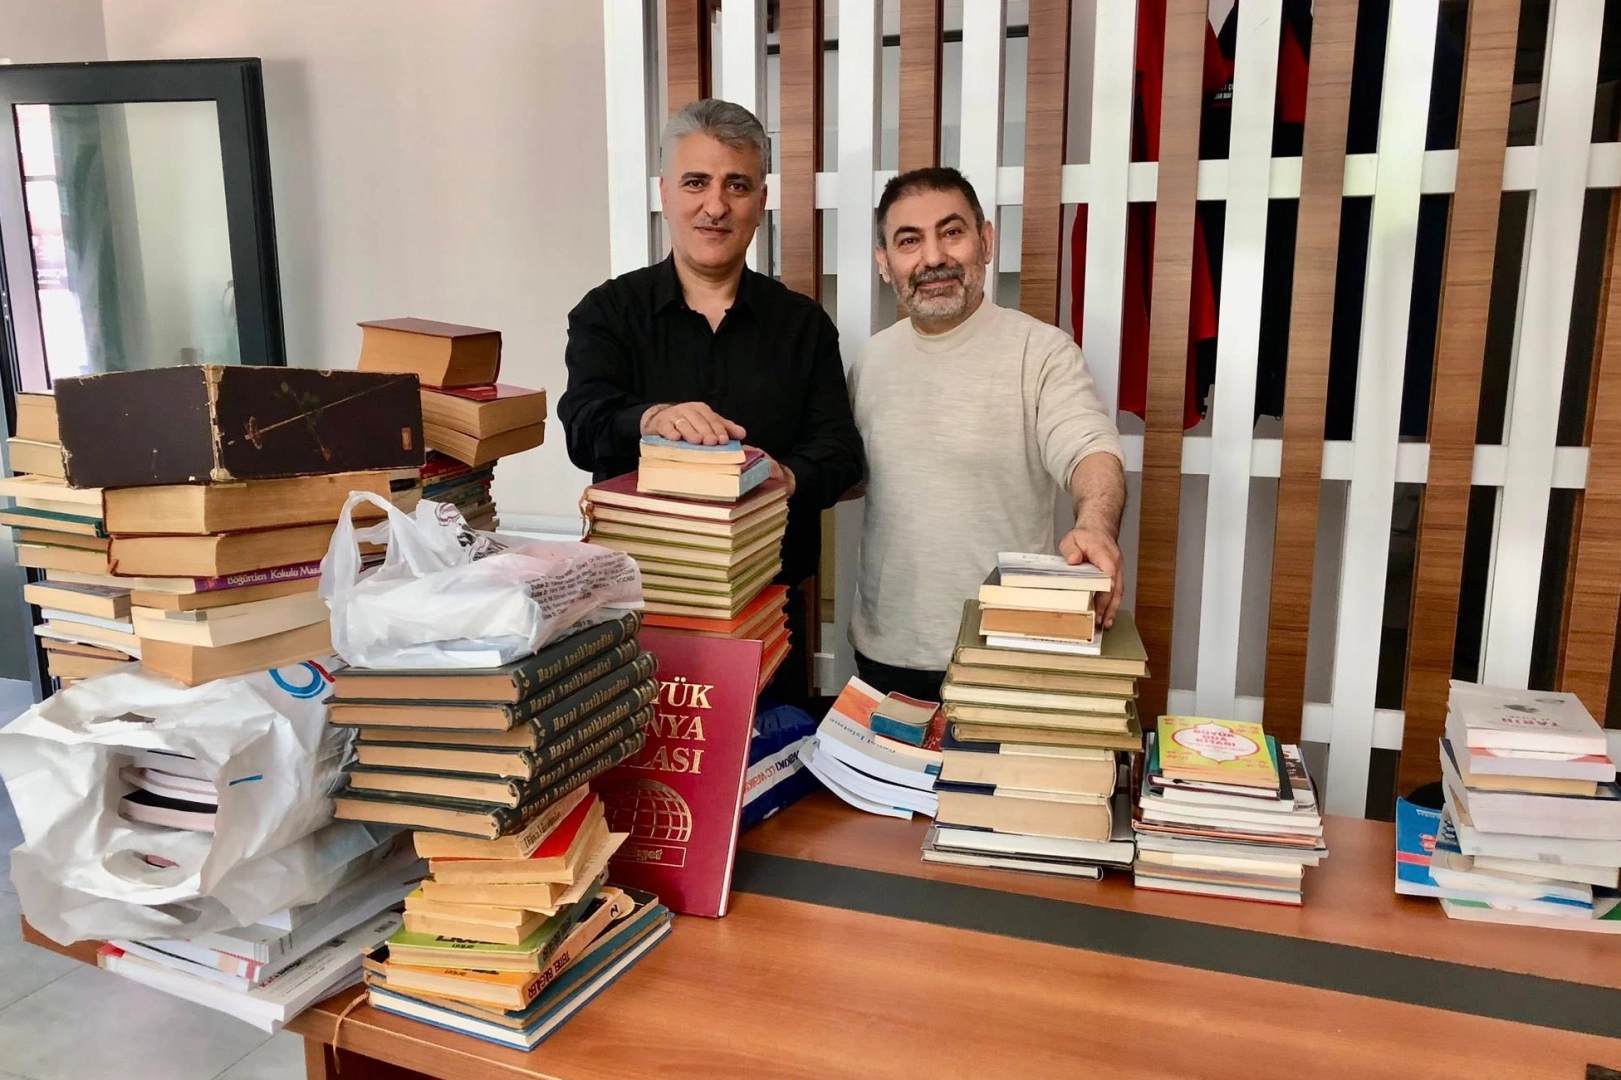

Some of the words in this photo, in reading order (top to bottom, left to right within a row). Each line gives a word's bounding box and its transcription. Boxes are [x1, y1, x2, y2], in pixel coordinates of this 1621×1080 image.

[227, 572, 267, 585] Böğürtlen
[270, 567, 299, 580] Kokulu
[649, 675, 714, 710] YÜK
[645, 713, 706, 742] NYA
[632, 745, 705, 775] ASI
